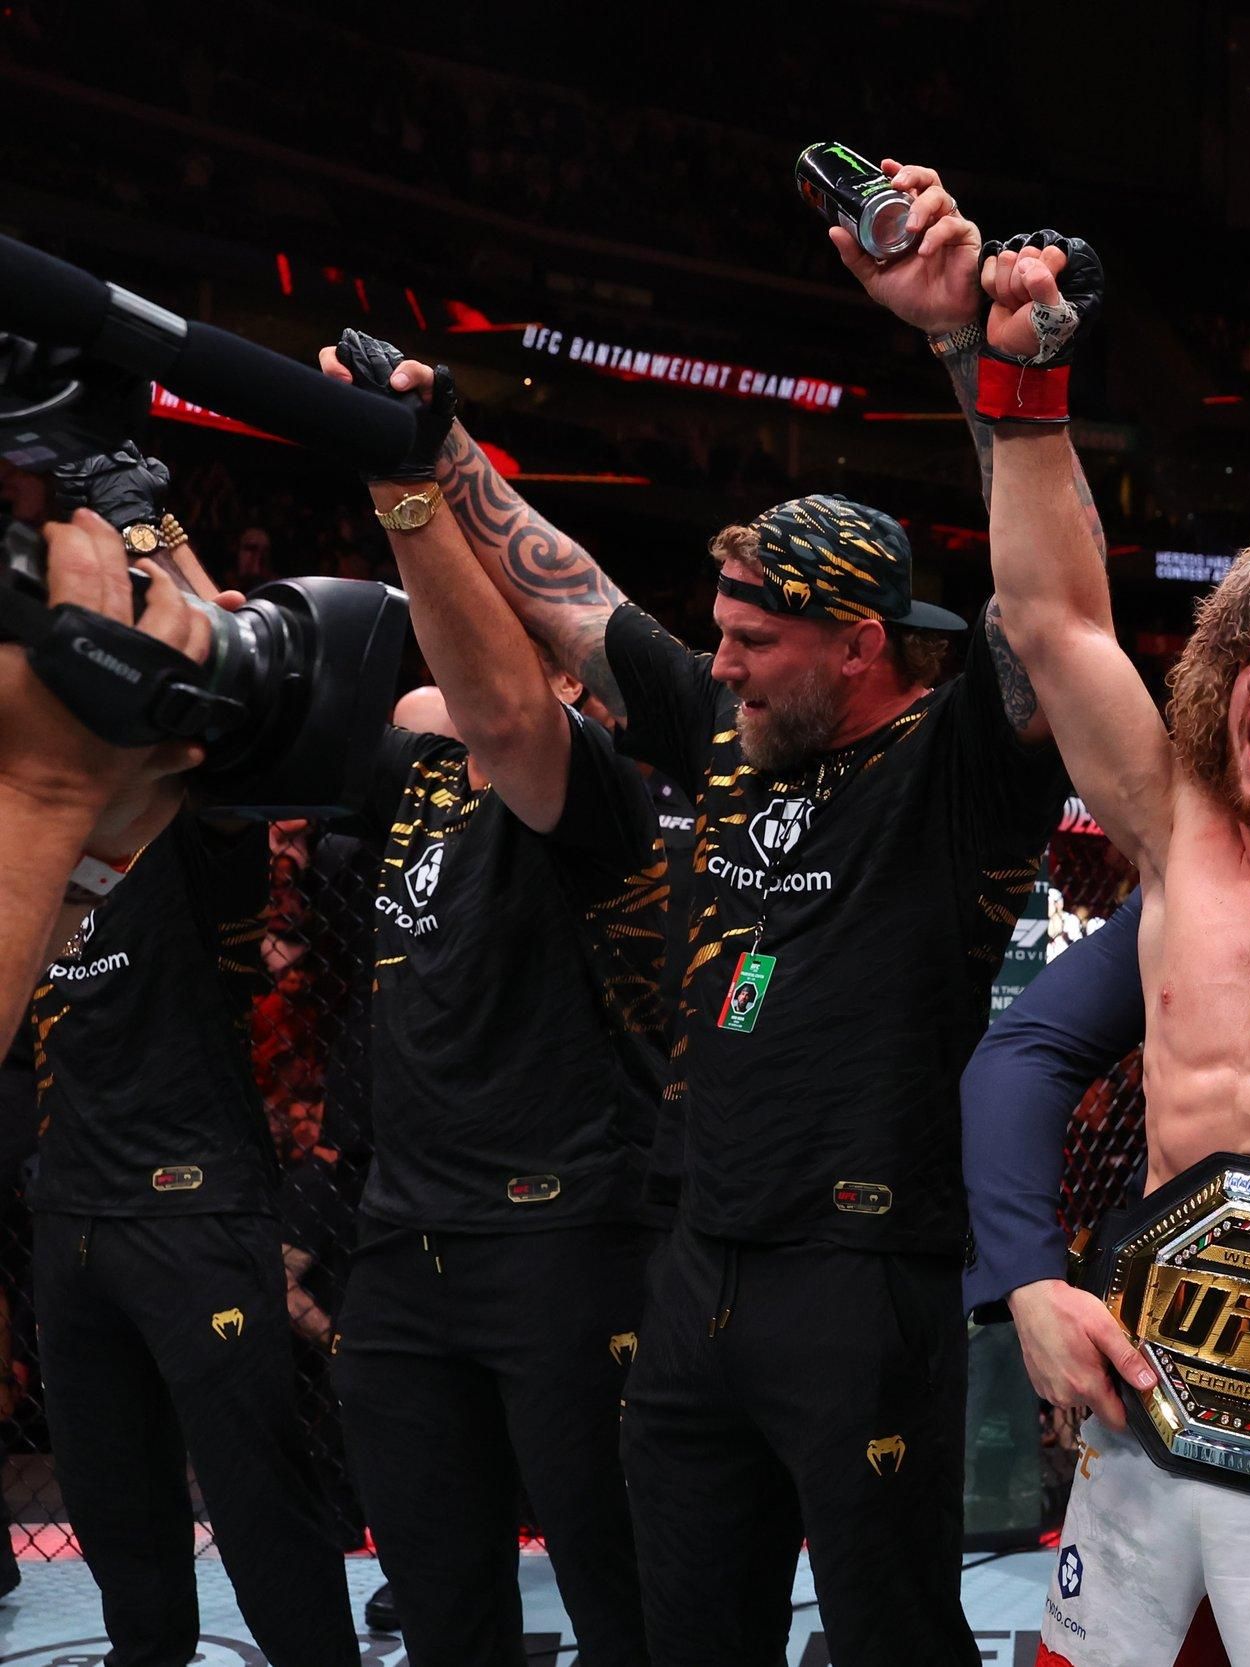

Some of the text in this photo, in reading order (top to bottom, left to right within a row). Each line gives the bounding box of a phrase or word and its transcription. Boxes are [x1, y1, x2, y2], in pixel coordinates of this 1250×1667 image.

[522, 323, 843, 408] UFC BANTAMWEIGHT CHAMPION
[72, 637, 142, 684] Canon
[658, 814, 695, 830] UFC
[47, 951, 130, 980] pto.com
[1004, 950, 1043, 961] MOVI
